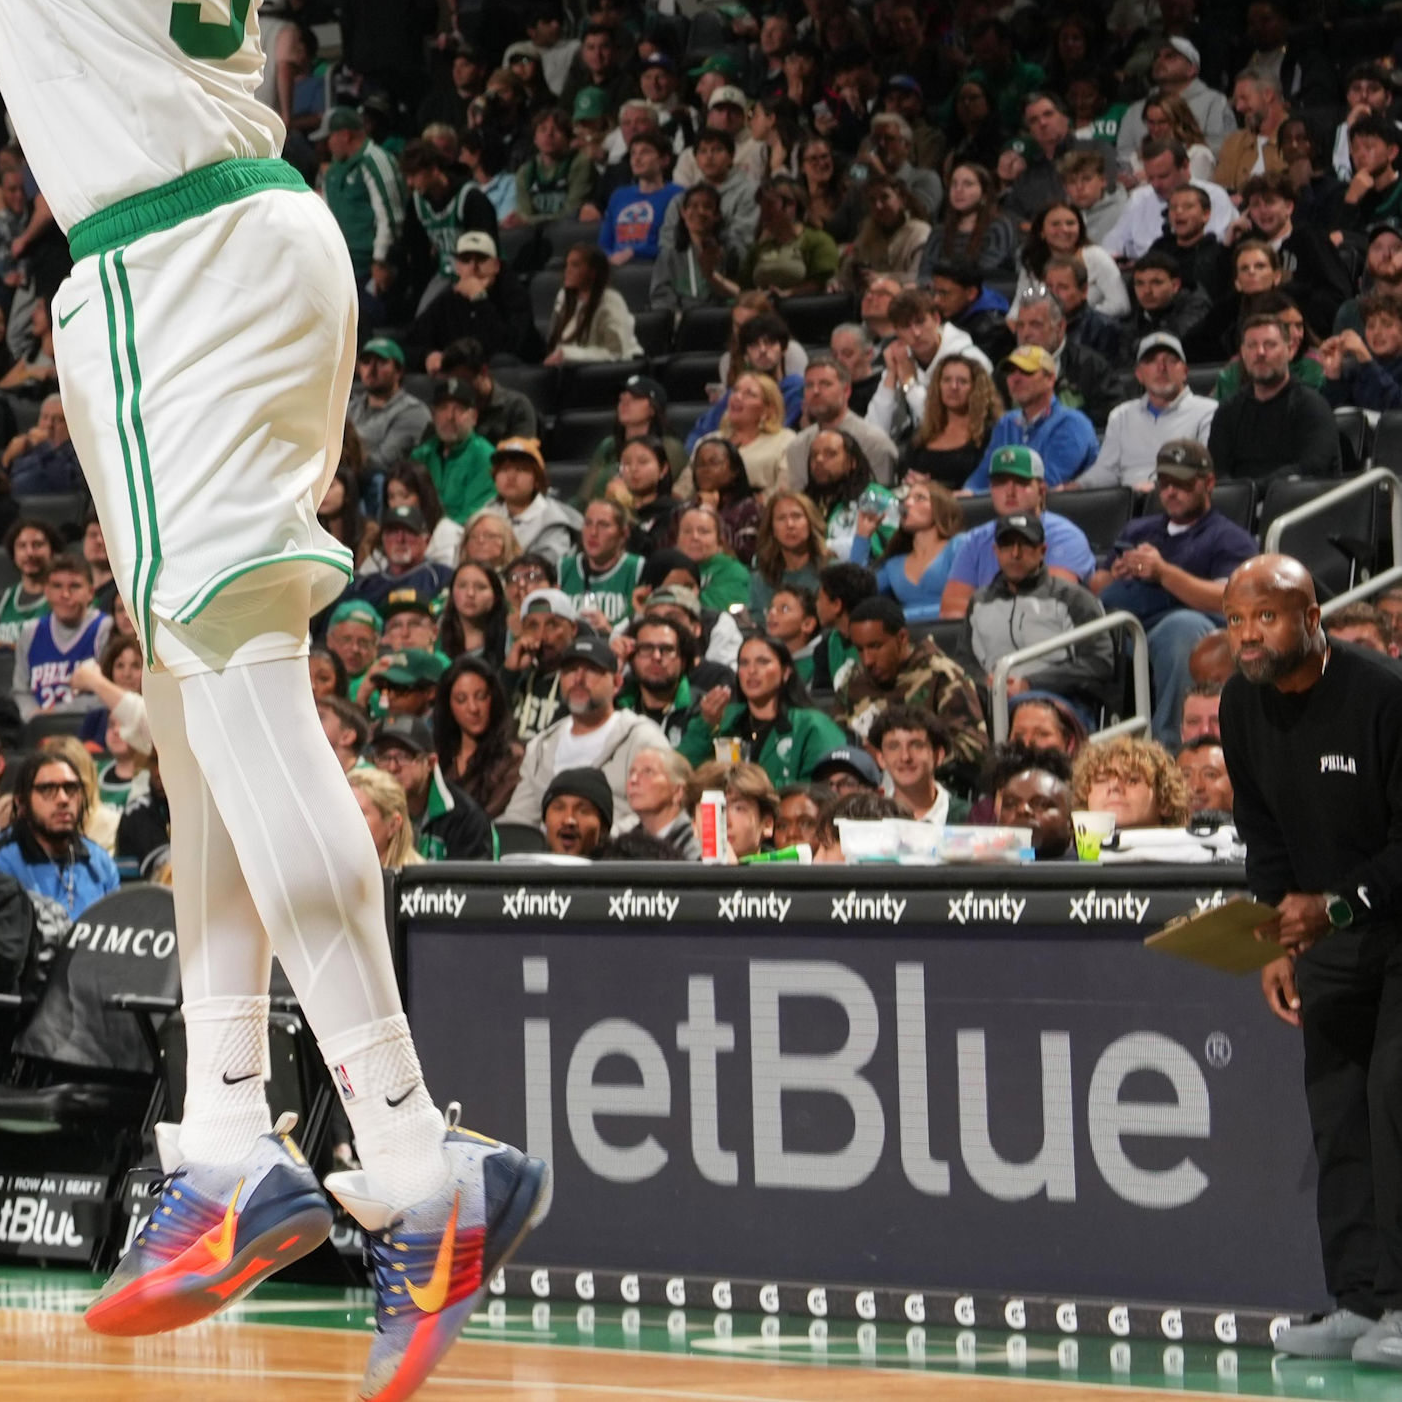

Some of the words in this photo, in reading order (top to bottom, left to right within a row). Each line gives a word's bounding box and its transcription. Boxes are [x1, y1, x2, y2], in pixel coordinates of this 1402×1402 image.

[1320, 754, 1357, 775] PHILA
[400, 887, 466, 919] xfinity
[502, 887, 571, 920] xfinity
[609, 888, 679, 921] xfinity
[718, 889, 791, 922] xfinity
[830, 890, 906, 924] xfinity
[947, 890, 1026, 925] xfinity
[1069, 891, 1150, 925] xfinity
[66, 922, 176, 959] PIMCO
[522, 955, 1210, 1226] jetBlue
[15, 1175, 41, 1192] ROW
[41, 1178, 56, 1193] AA
